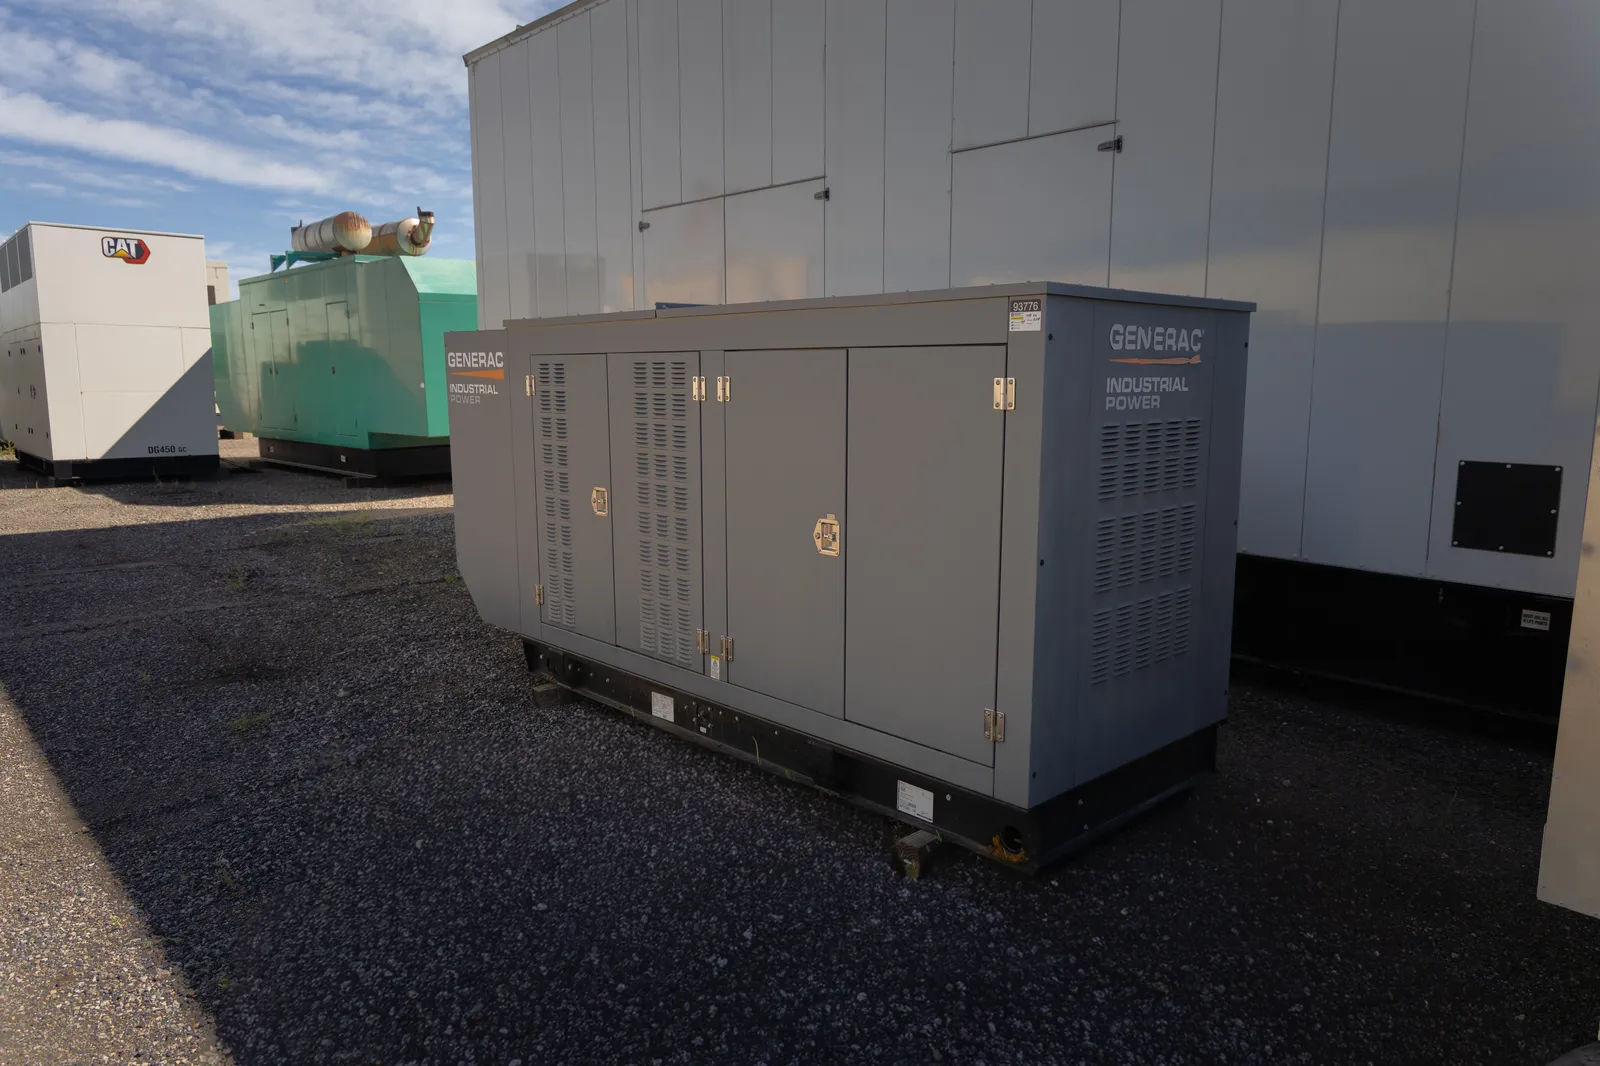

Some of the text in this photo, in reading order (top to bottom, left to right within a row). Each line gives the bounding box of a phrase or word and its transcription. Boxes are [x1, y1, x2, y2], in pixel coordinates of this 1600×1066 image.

[102, 237, 139, 259] CAT
[1013, 301, 1039, 312] 93776
[1109, 323, 1203, 352] GENERAC
[447, 351, 504, 368] GENERAC
[449, 383, 499, 395] INDUSTRIAL
[1106, 377, 1189, 393] INDUSTRIAL
[449, 394, 481, 405] POWER
[1105, 395, 1161, 411] POWER
[147, 445, 176, 454] DG450
